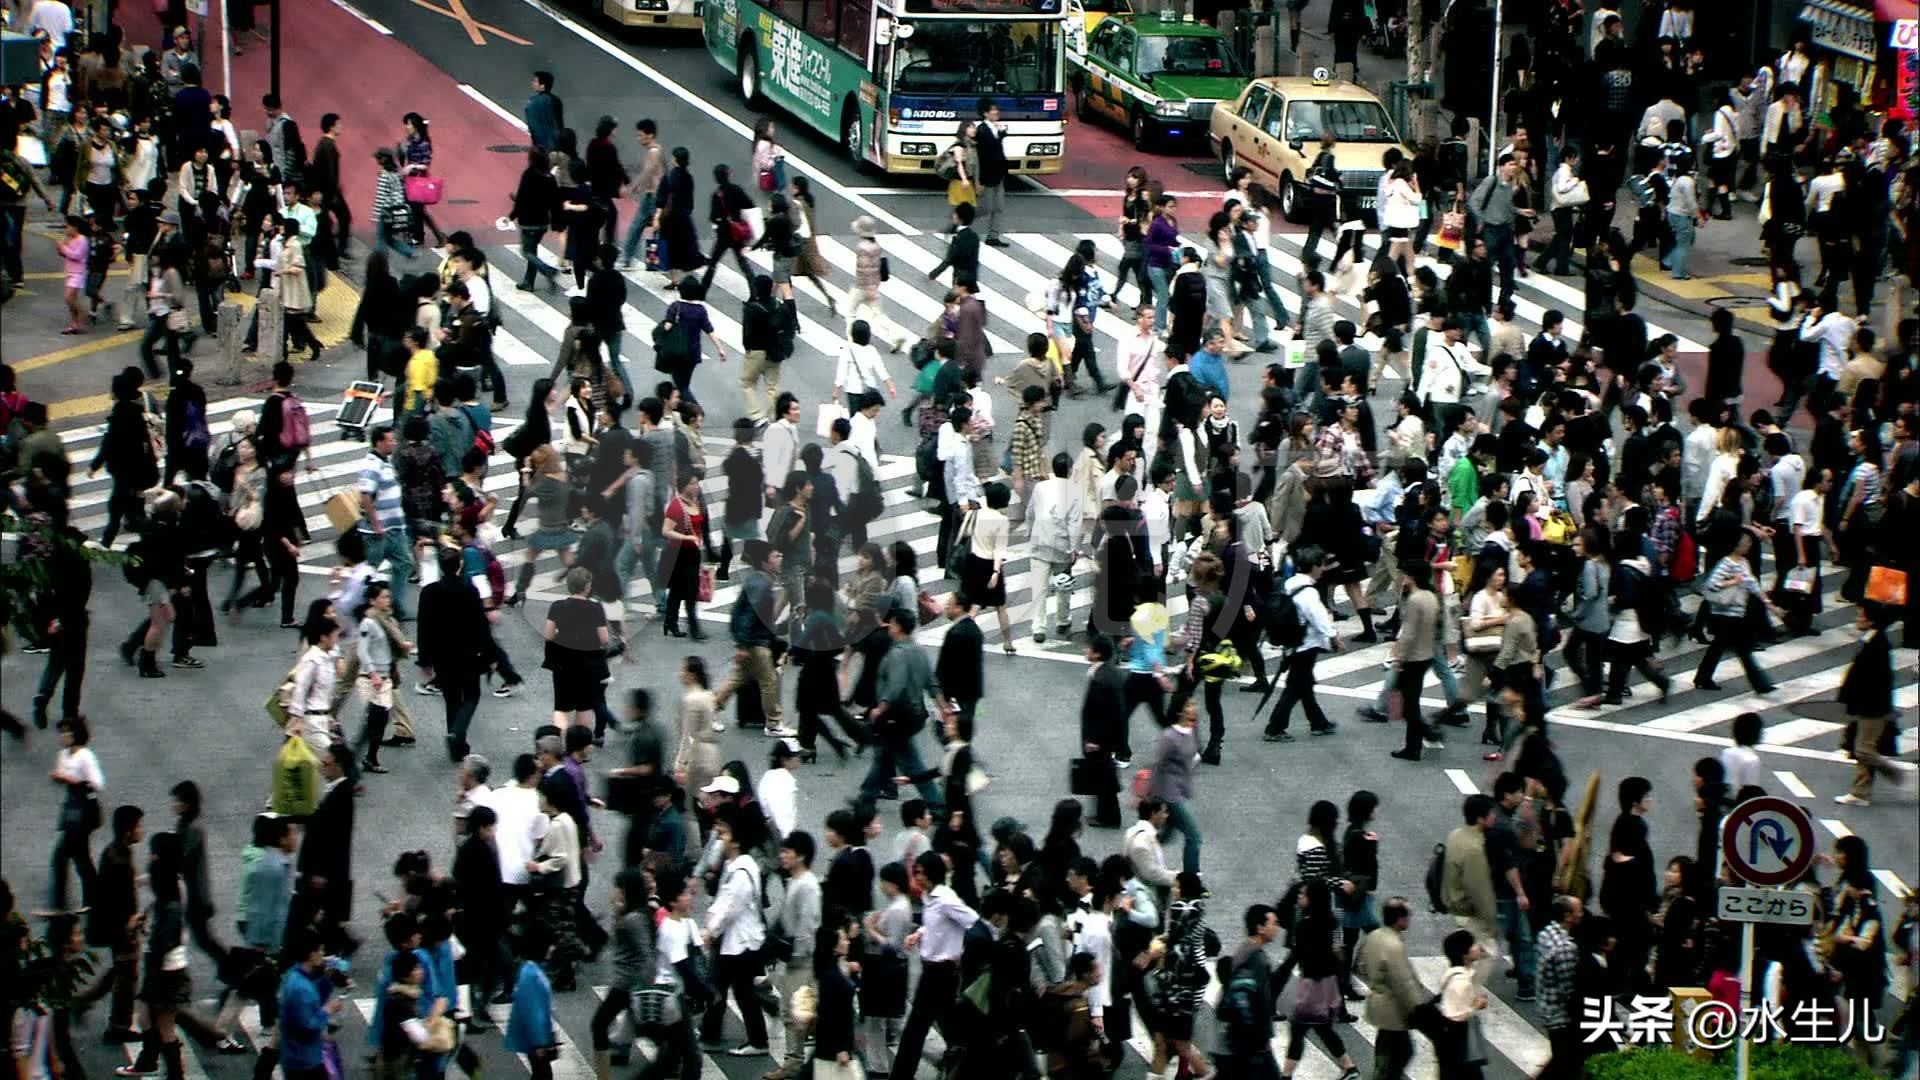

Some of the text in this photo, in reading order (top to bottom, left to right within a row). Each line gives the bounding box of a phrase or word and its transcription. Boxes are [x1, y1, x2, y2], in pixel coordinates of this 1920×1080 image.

[772, 20, 802, 96] 東進
[913, 110, 956, 118] KEIO BUS
[1724, 896, 1808, 918] ここから
